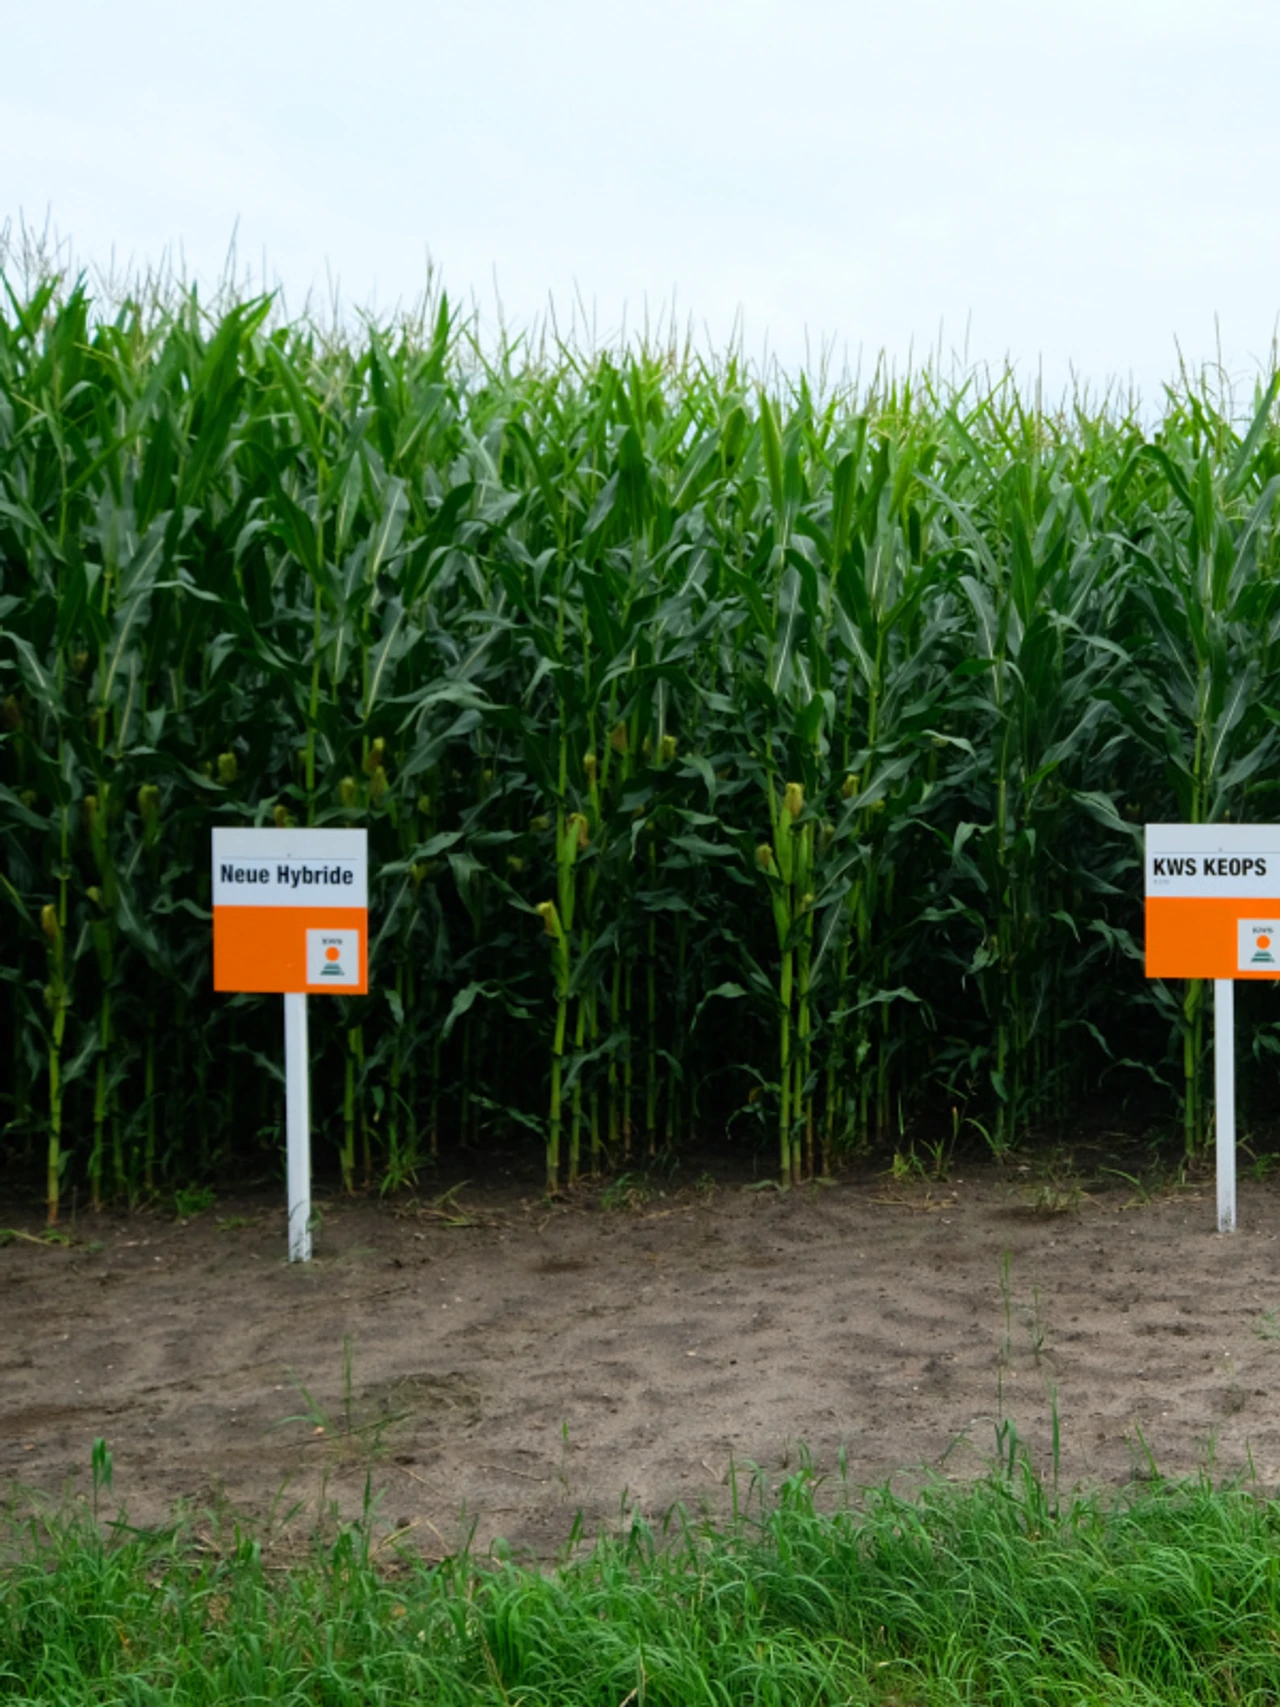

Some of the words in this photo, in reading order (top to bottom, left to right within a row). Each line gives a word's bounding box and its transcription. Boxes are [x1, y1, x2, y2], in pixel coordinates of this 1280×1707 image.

[220, 864, 270, 884] Neue
[277, 864, 354, 889] Hybride
[1153, 858, 1197, 876] KWS
[1203, 858, 1267, 876] KEOPS
